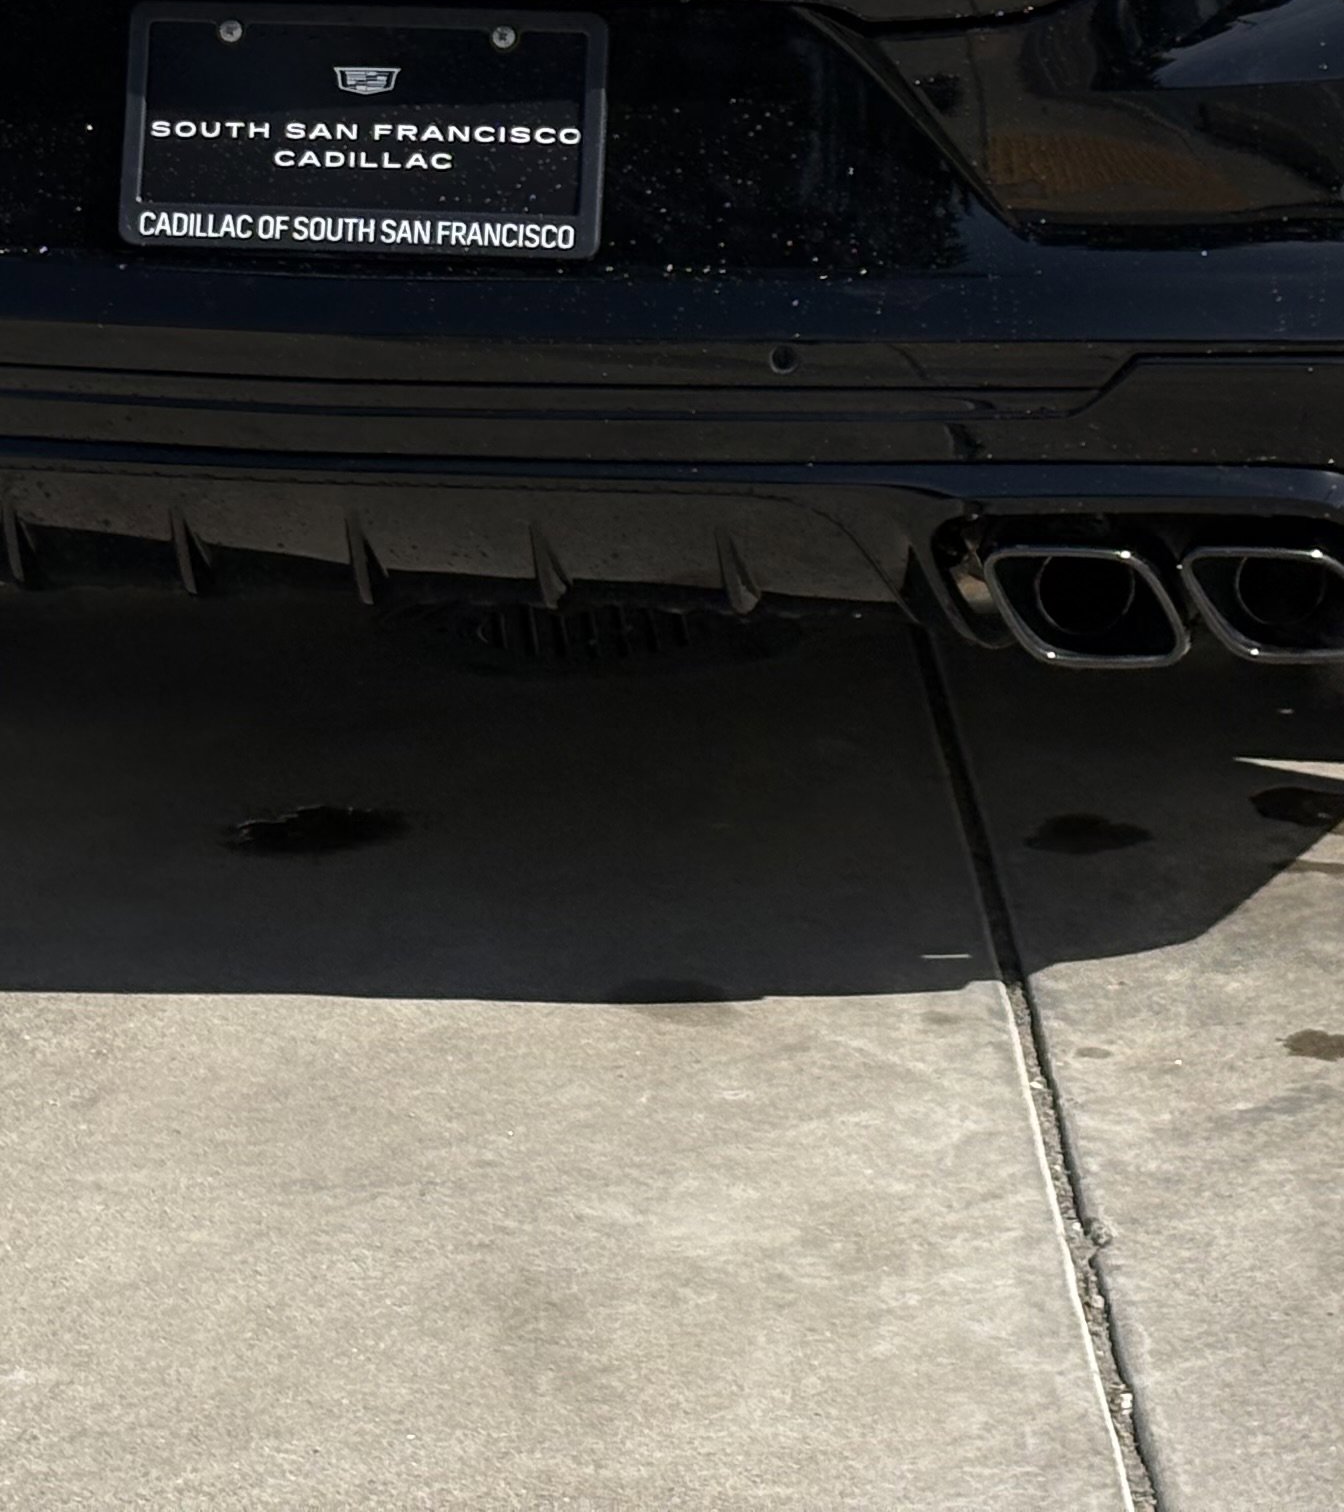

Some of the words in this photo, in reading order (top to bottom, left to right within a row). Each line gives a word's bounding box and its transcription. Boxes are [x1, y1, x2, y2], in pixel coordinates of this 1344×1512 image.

[150, 120, 270, 139] SOUTH
[285, 122, 358, 141] SAN
[373, 123, 582, 145] FRANCISCO
[273, 150, 453, 170] CADILLAC
[139, 211, 254, 239] CADILLAC
[257, 214, 290, 240] OF
[292, 216, 376, 243] SOUTH
[380, 219, 432, 245] SAN
[437, 220, 575, 250] FRANCISCO
